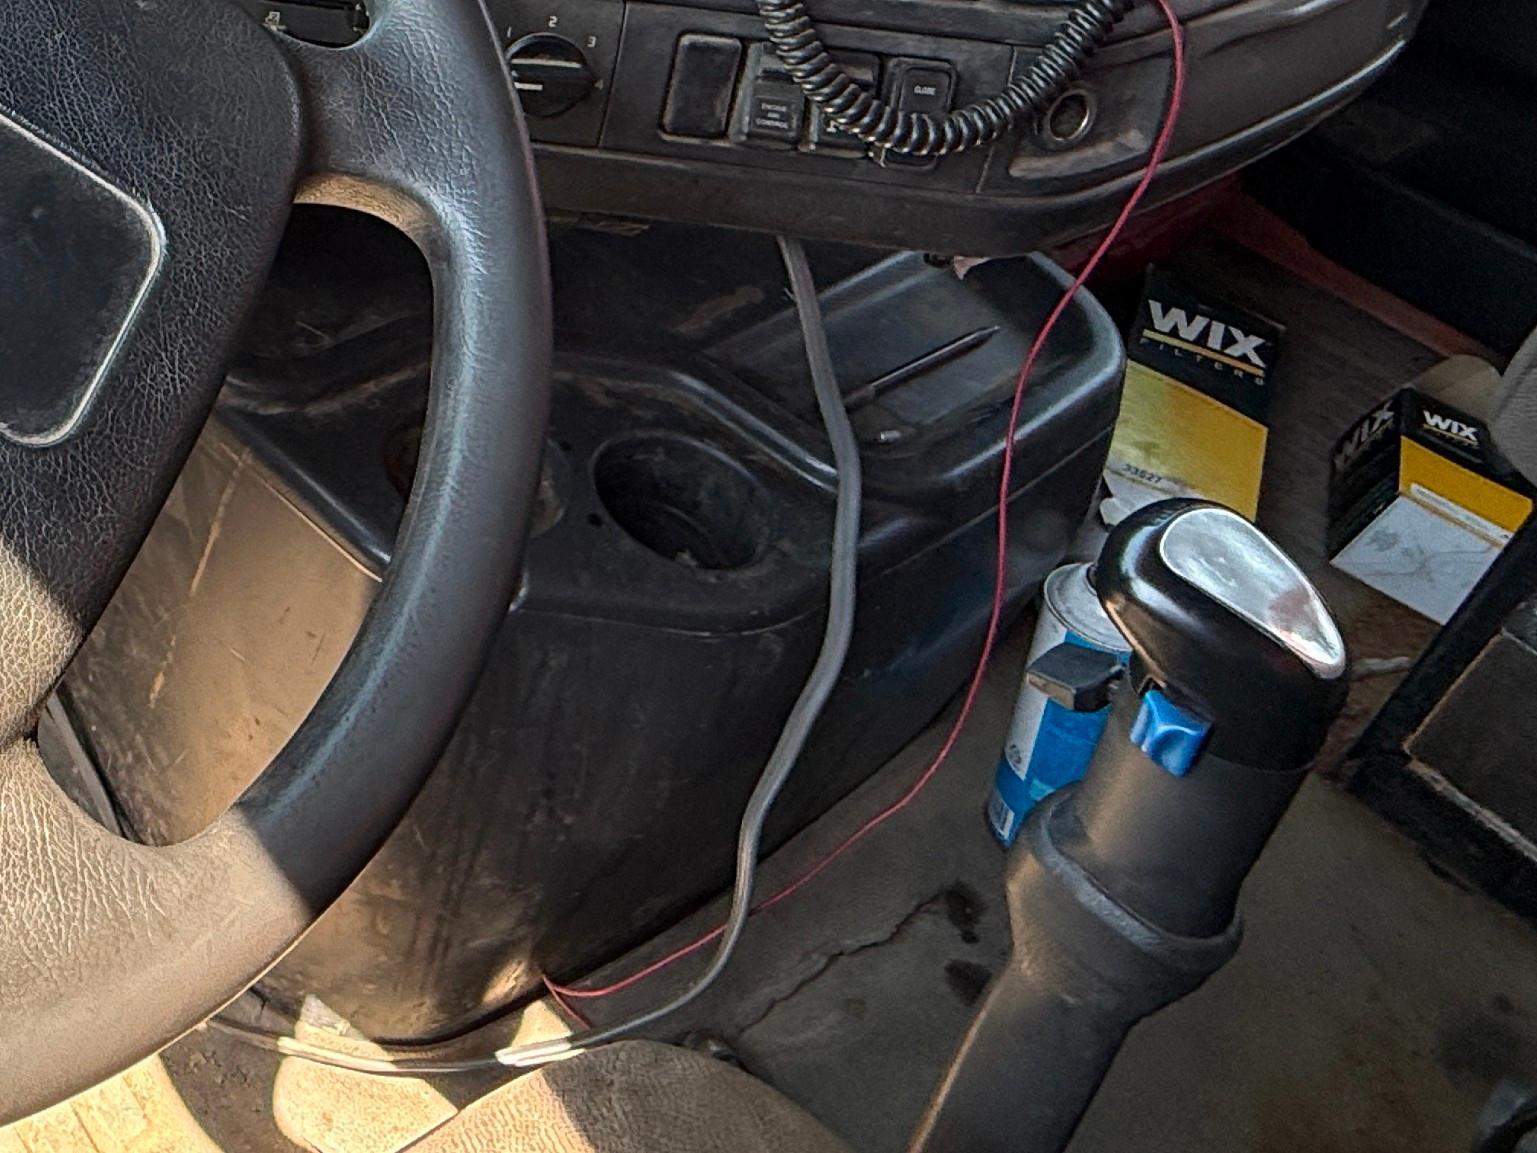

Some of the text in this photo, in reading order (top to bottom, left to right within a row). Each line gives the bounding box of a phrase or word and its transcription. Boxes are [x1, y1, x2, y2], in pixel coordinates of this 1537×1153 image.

[548, 15, 559, 28] 2
[587, 36, 597, 47] 3
[1148, 299, 1267, 368] WIX
[1140, 336, 1265, 386] FILTERS
[1423, 409, 1480, 442] WIX
